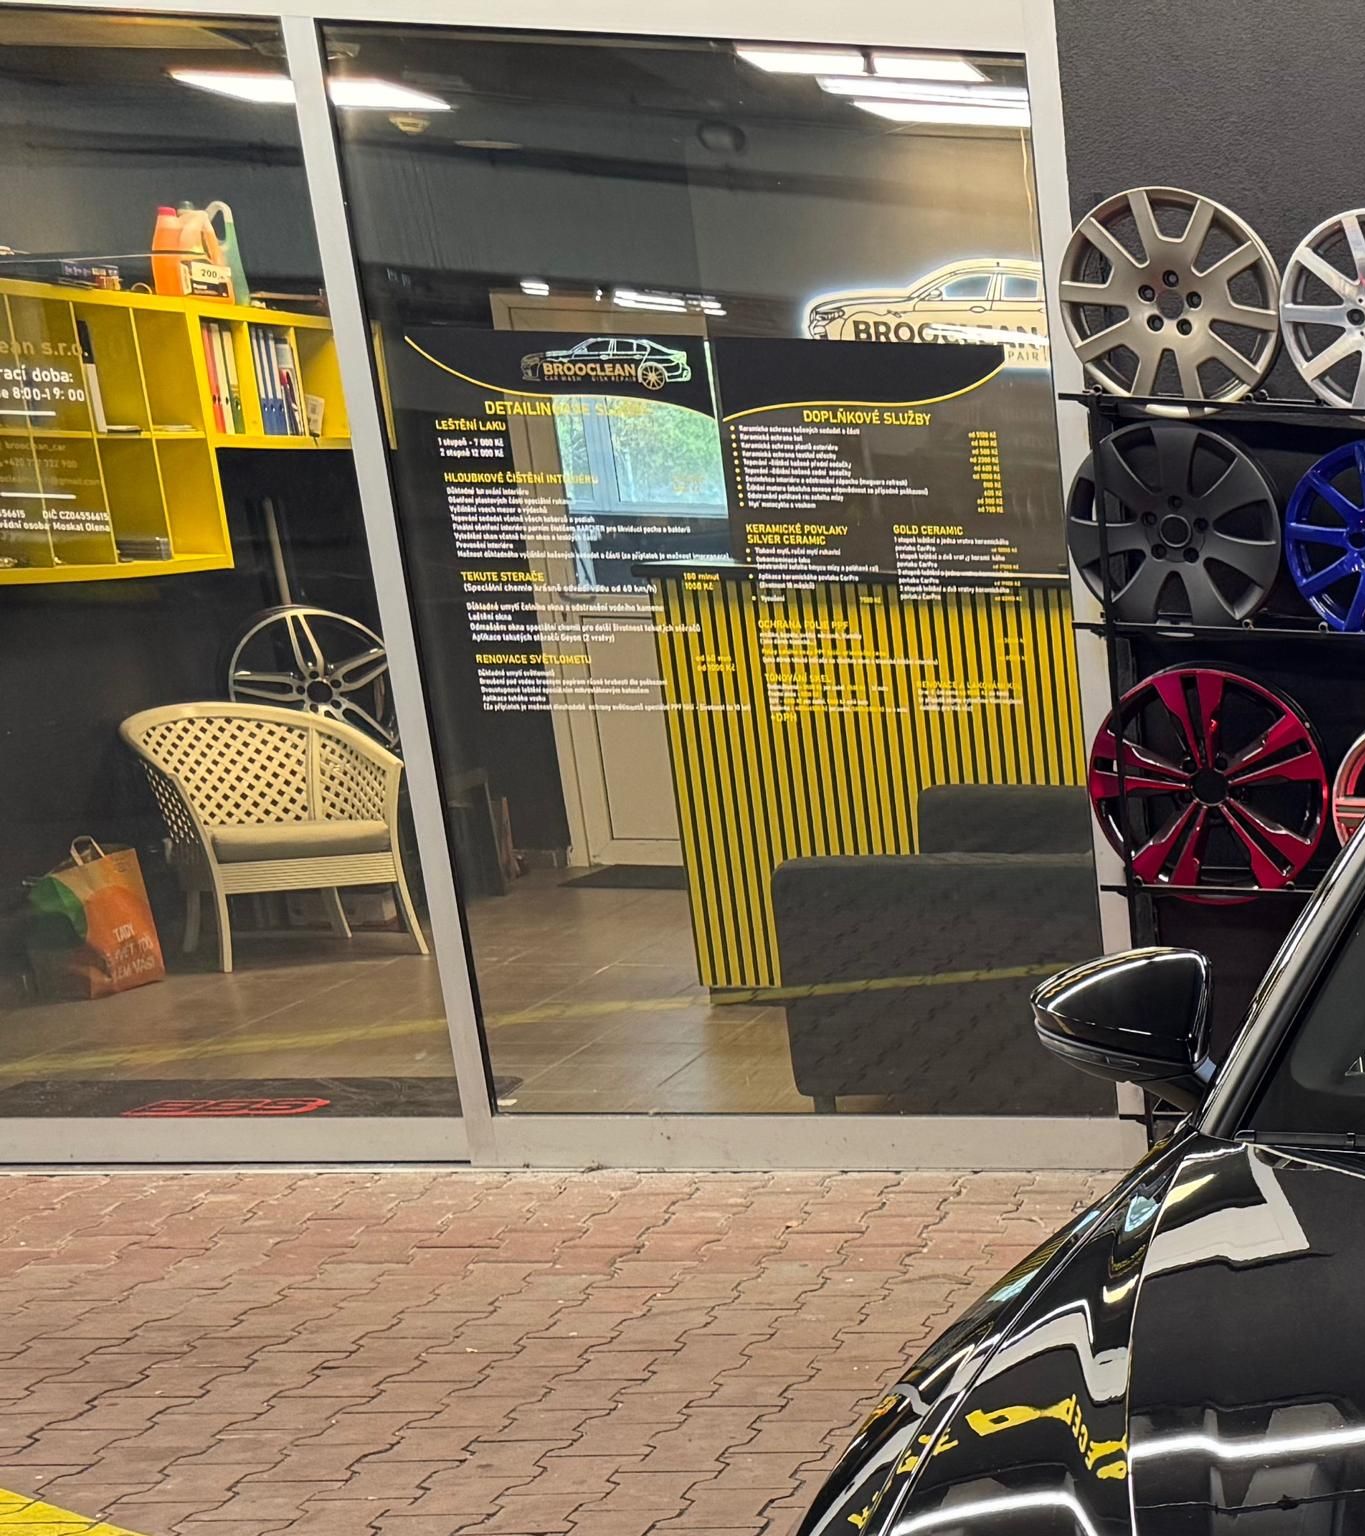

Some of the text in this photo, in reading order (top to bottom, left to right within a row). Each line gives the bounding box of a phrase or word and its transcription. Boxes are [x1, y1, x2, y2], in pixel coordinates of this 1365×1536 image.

[1008, 350, 1040, 361] PAIR
[32, 367, 74, 383] doba:
[543, 361, 637, 377] BROOCLEAN
[803, 408, 931, 426] DOPLŇKOVÉ SLUŽBY
[480, 421, 506, 432] LAKU
[444, 471, 504, 483] HLOUBKOVÉ
[745, 524, 848, 536] KERAMICKÉ POVLAKY
[893, 524, 963, 536] GOLD CERAMIC
[747, 534, 826, 545] SILVER CERAMIC
[460, 570, 545, 581] TEKUTE STERAČE
[475, 654, 527, 664] RENOVACE
